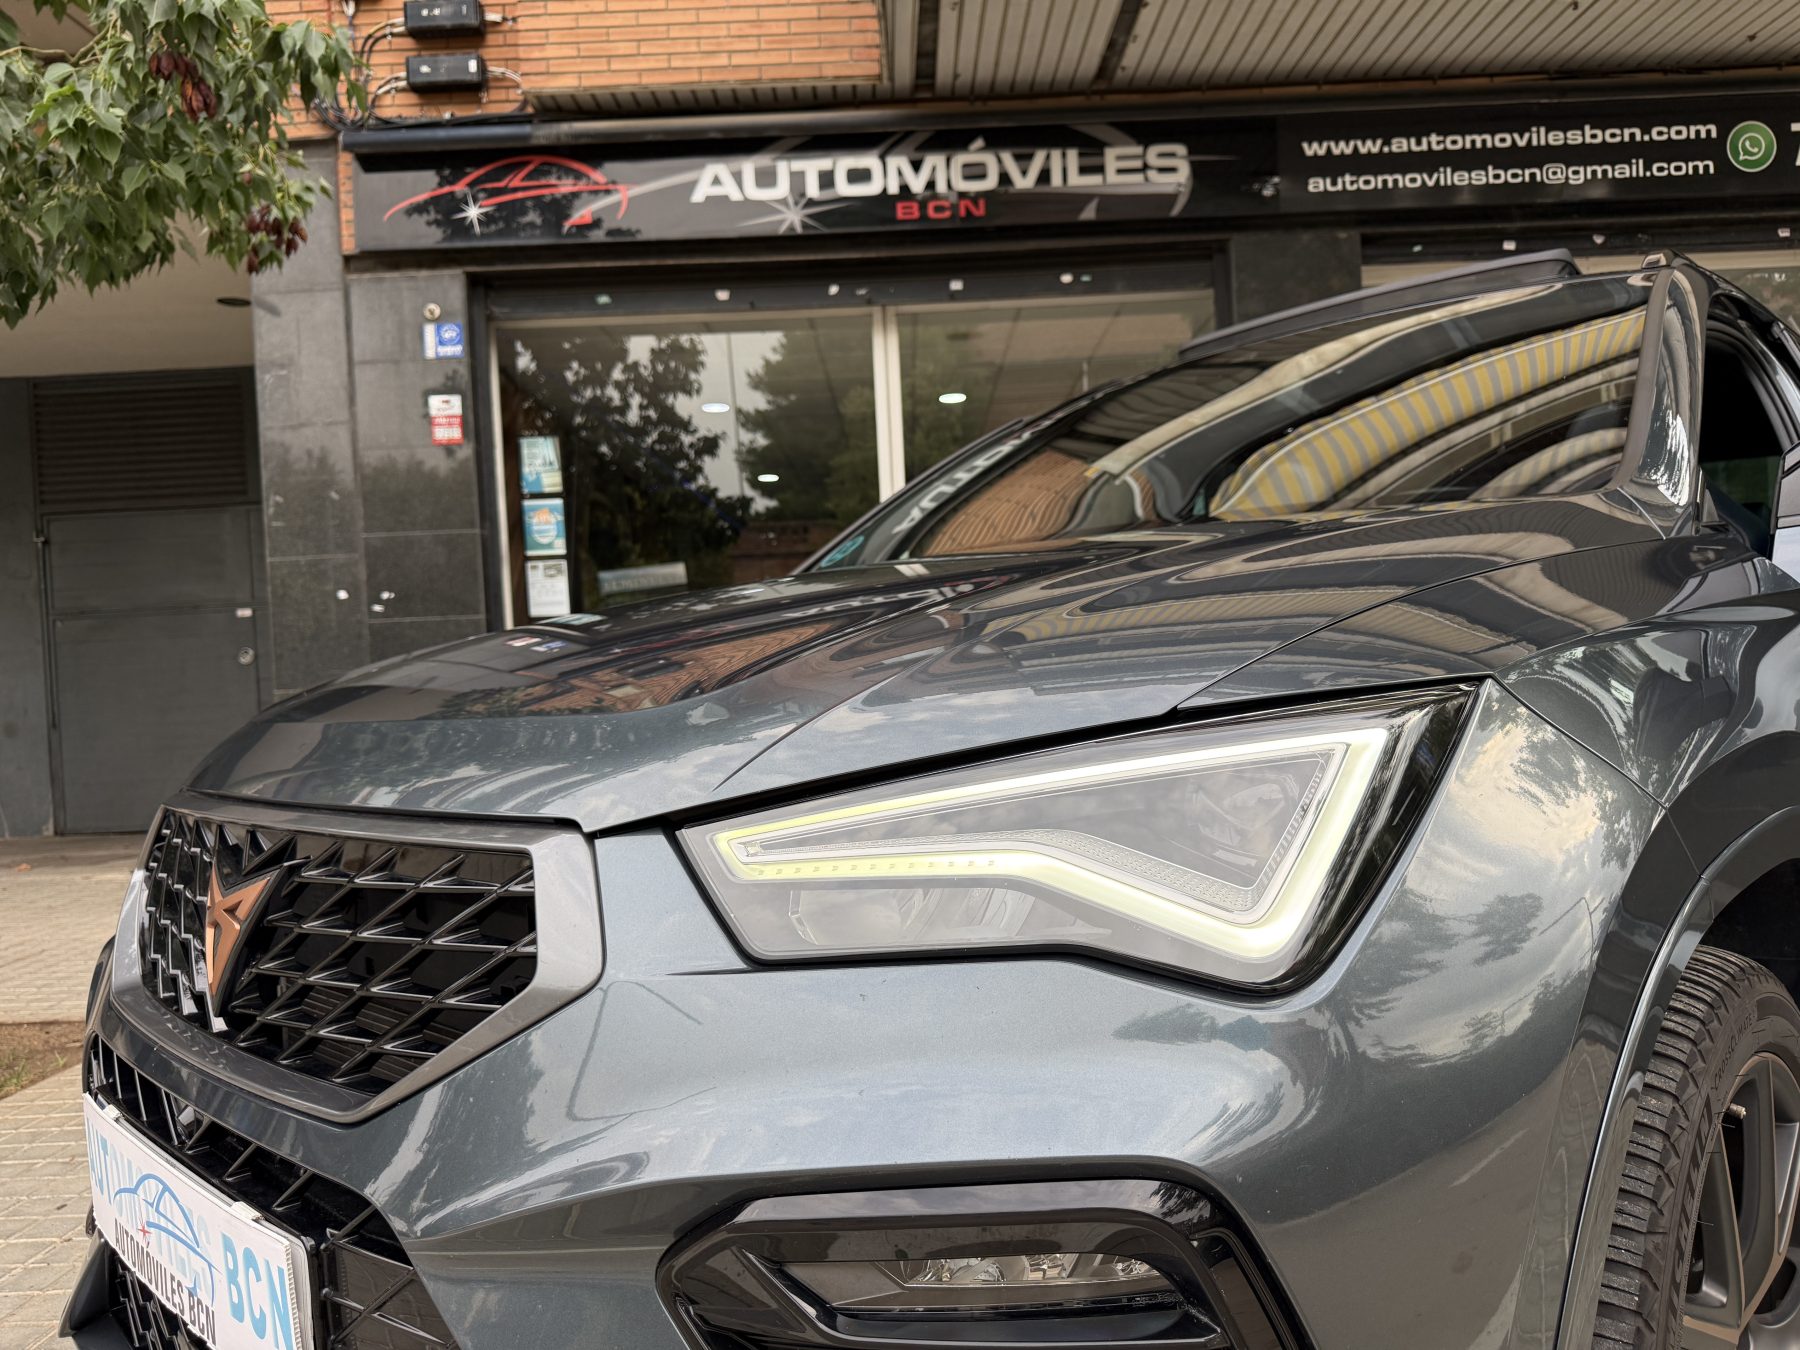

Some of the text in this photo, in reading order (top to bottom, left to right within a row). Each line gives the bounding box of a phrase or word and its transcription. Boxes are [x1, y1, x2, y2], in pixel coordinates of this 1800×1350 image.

[1302, 122, 1717, 157] www.automovilesbcn.com
[690, 136, 1190, 203] AUTOMÓVILES
[1307, 157, 1715, 193] automovilesbcn@gmail.com
[895, 198, 987, 221] BCN
[221, 1231, 296, 1350] BCN
